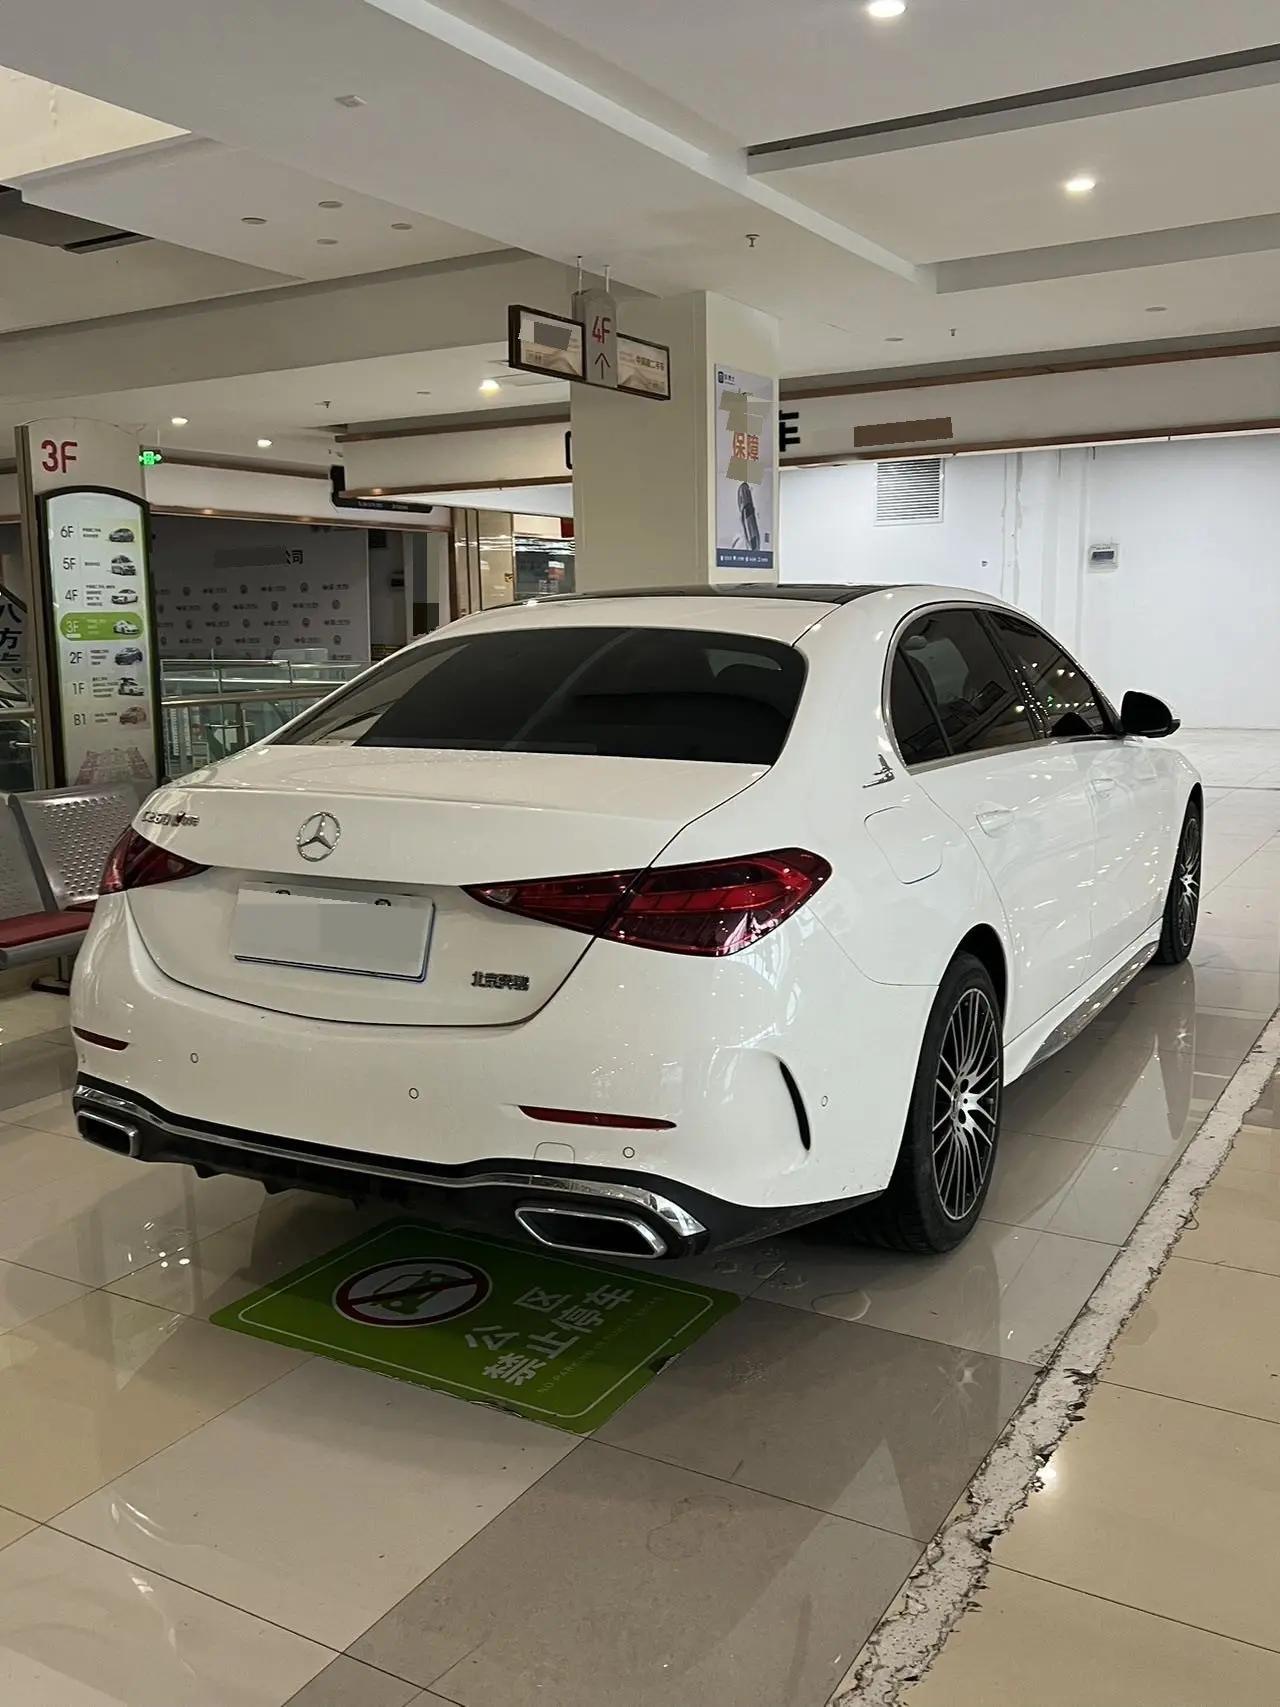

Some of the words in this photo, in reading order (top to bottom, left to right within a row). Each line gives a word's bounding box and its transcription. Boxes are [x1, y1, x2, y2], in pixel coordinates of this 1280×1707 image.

[592, 315, 611, 344] 4F
[733, 431, 760, 461] 保障
[41, 440, 78, 474] 3F
[60, 525, 75, 539] 6F
[62, 557, 77, 571] 5F
[65, 589, 79, 602] 4F
[66, 621, 80, 634] 3F
[69, 651, 83, 665] 2F
[72, 682, 85, 695] 1F
[74, 713, 87, 726] B1
[483, 1284, 635, 1386] 禁止停车
